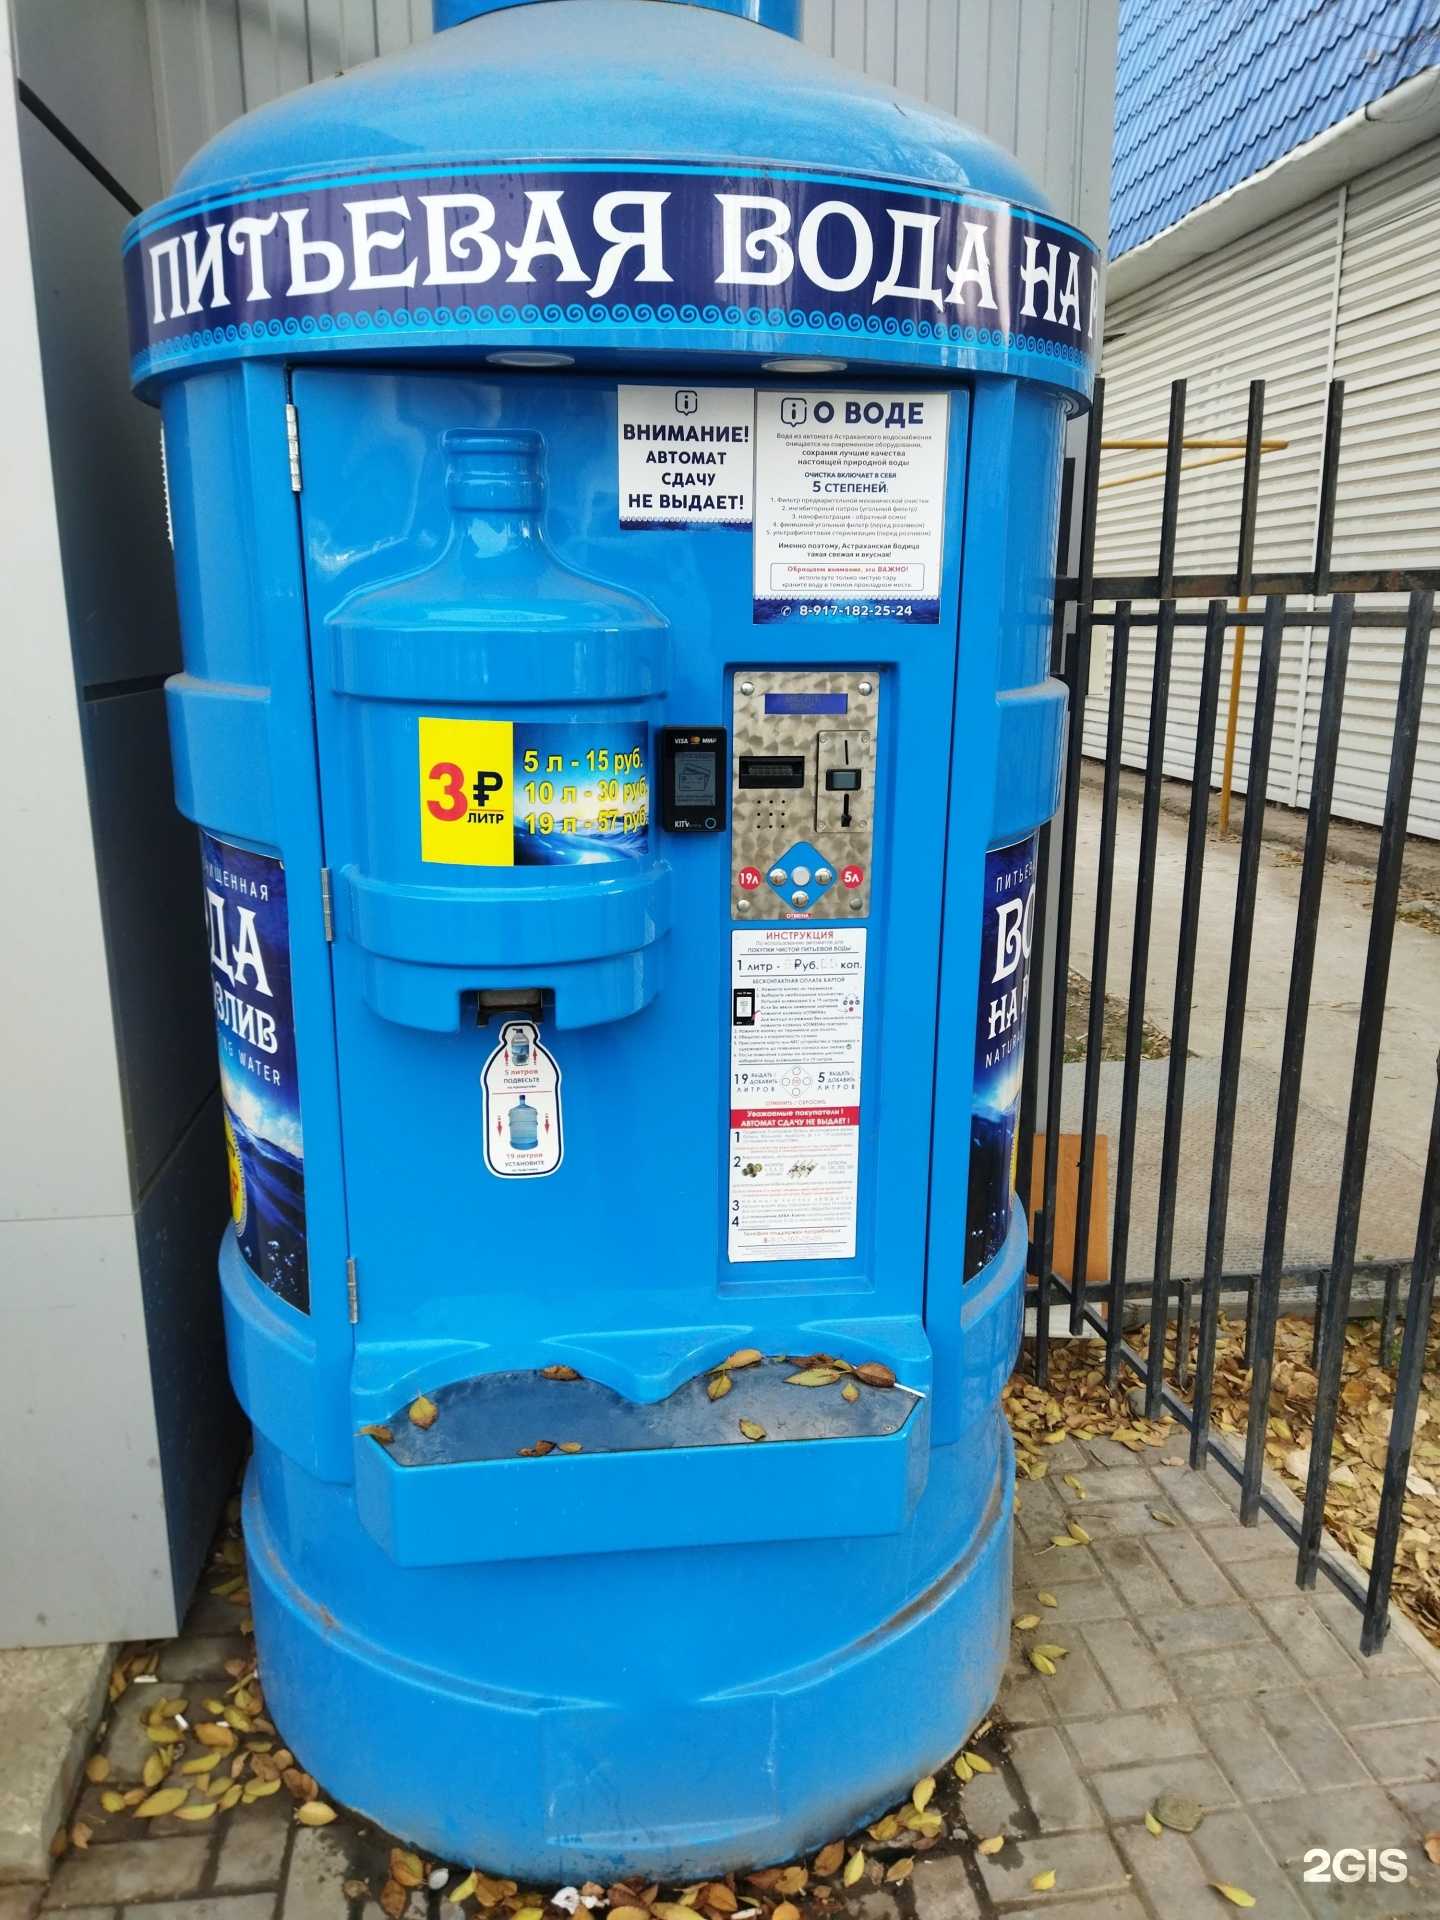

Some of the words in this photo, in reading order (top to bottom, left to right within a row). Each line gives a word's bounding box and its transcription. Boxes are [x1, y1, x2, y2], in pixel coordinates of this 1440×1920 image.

[149, 191, 675, 324] ПИТЬЕВАЯ
[714, 193, 998, 313] ВОДА
[1020, 236, 1082, 332] НА
[813, 401, 835, 424] О
[845, 402, 924, 429] ВОДЕ
[623, 424, 749, 443] ВНИМАНИЕ!
[777, 433, 793, 441] Вода
[645, 451, 727, 465] АВТОМАТ
[802, 450, 838, 458] сохраняя
[839, 450, 869, 458] лучшие
[797, 459, 842, 467] настоящей
[843, 459, 887, 467] природной
[661, 472, 716, 488] СДАЧУ
[804, 471, 836, 479] ОЧИСТКА
[837, 471, 873, 479] ВКЛЮЧАЕТ
[874, 471, 879, 479] В
[880, 471, 897, 479] СЕБЯ
[812, 480, 821, 493] 5
[628, 494, 653, 508] НЕ
[659, 495, 744, 512] ВЫДАЕТ!
[841, 542, 892, 551] Астраханская
[799, 605, 913, 617] 8-917-182-25-24
[523, 749, 539, 773] 5
[546, 755, 563, 773] л
[586, 749, 609, 772] 15
[614, 746, 644, 776] руб.
[426, 762, 468, 822] 3
[525, 781, 554, 805] 10
[561, 786, 577, 804] л
[597, 779, 619, 801] 30
[467, 812, 504, 824] ЛИТР
[525, 811, 554, 835] 19
[561, 817, 578, 834] л
[597, 809, 619, 833] 57
[766, 931, 834, 940] ИНСТРУКЦИЯ
[205, 887, 274, 998] ДА
[736, 959, 742, 971] 1
[747, 963, 773, 973] литр
[840, 960, 863, 969] коп.
[986, 986, 1018, 1040] НА
[238, 1049, 281, 1086] WATER
[734, 1073, 749, 1085] 19
[817, 1071, 825, 1083] 5
[777, 1119, 804, 1127] СДАЧУ
[817, 1118, 847, 1126] ВЫДАЕТ
[734, 1131, 740, 1143] 1
[733, 1156, 742, 1168] 2
[731, 1200, 740, 1212] 3
[731, 1216, 740, 1228] 4
